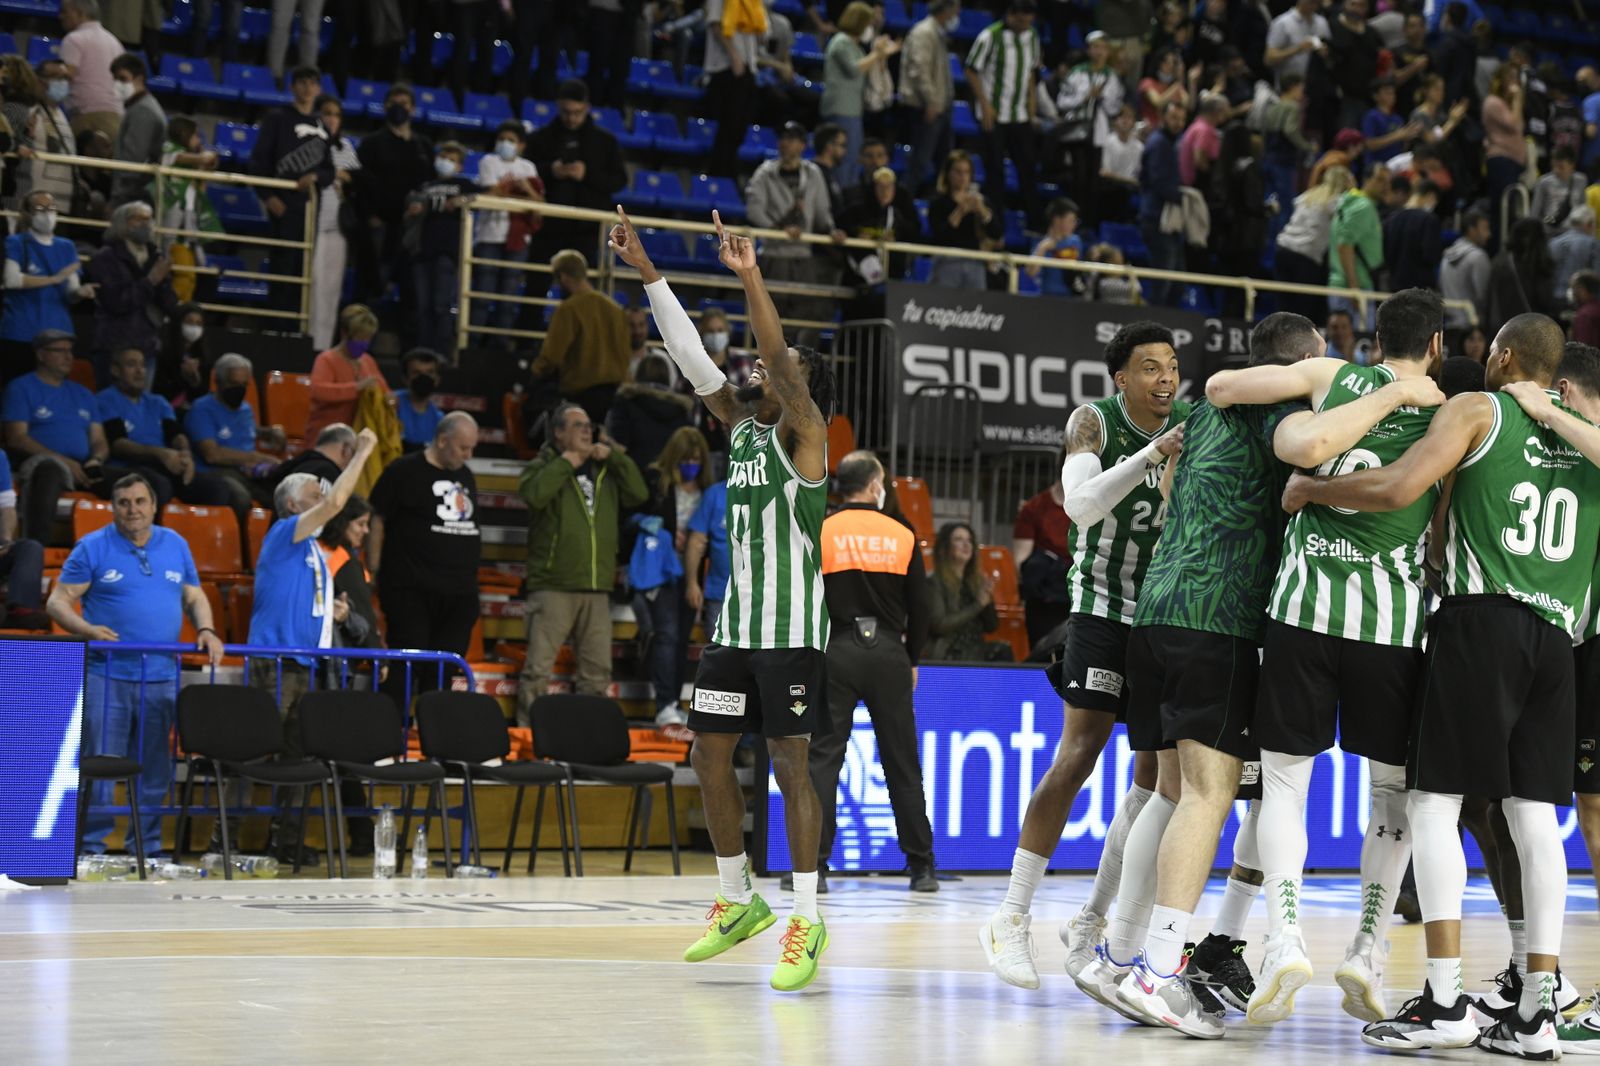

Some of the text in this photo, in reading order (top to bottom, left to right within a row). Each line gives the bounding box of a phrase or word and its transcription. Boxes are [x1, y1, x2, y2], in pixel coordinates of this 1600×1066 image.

[902, 300, 1005, 332] tu copiadora
[902, 343, 1117, 408] SIDICO
[1130, 500, 1168, 532] 24
[1501, 481, 1579, 562] 30
[832, 533, 898, 552] VITEN
[1305, 533, 1364, 557] Sevilla
